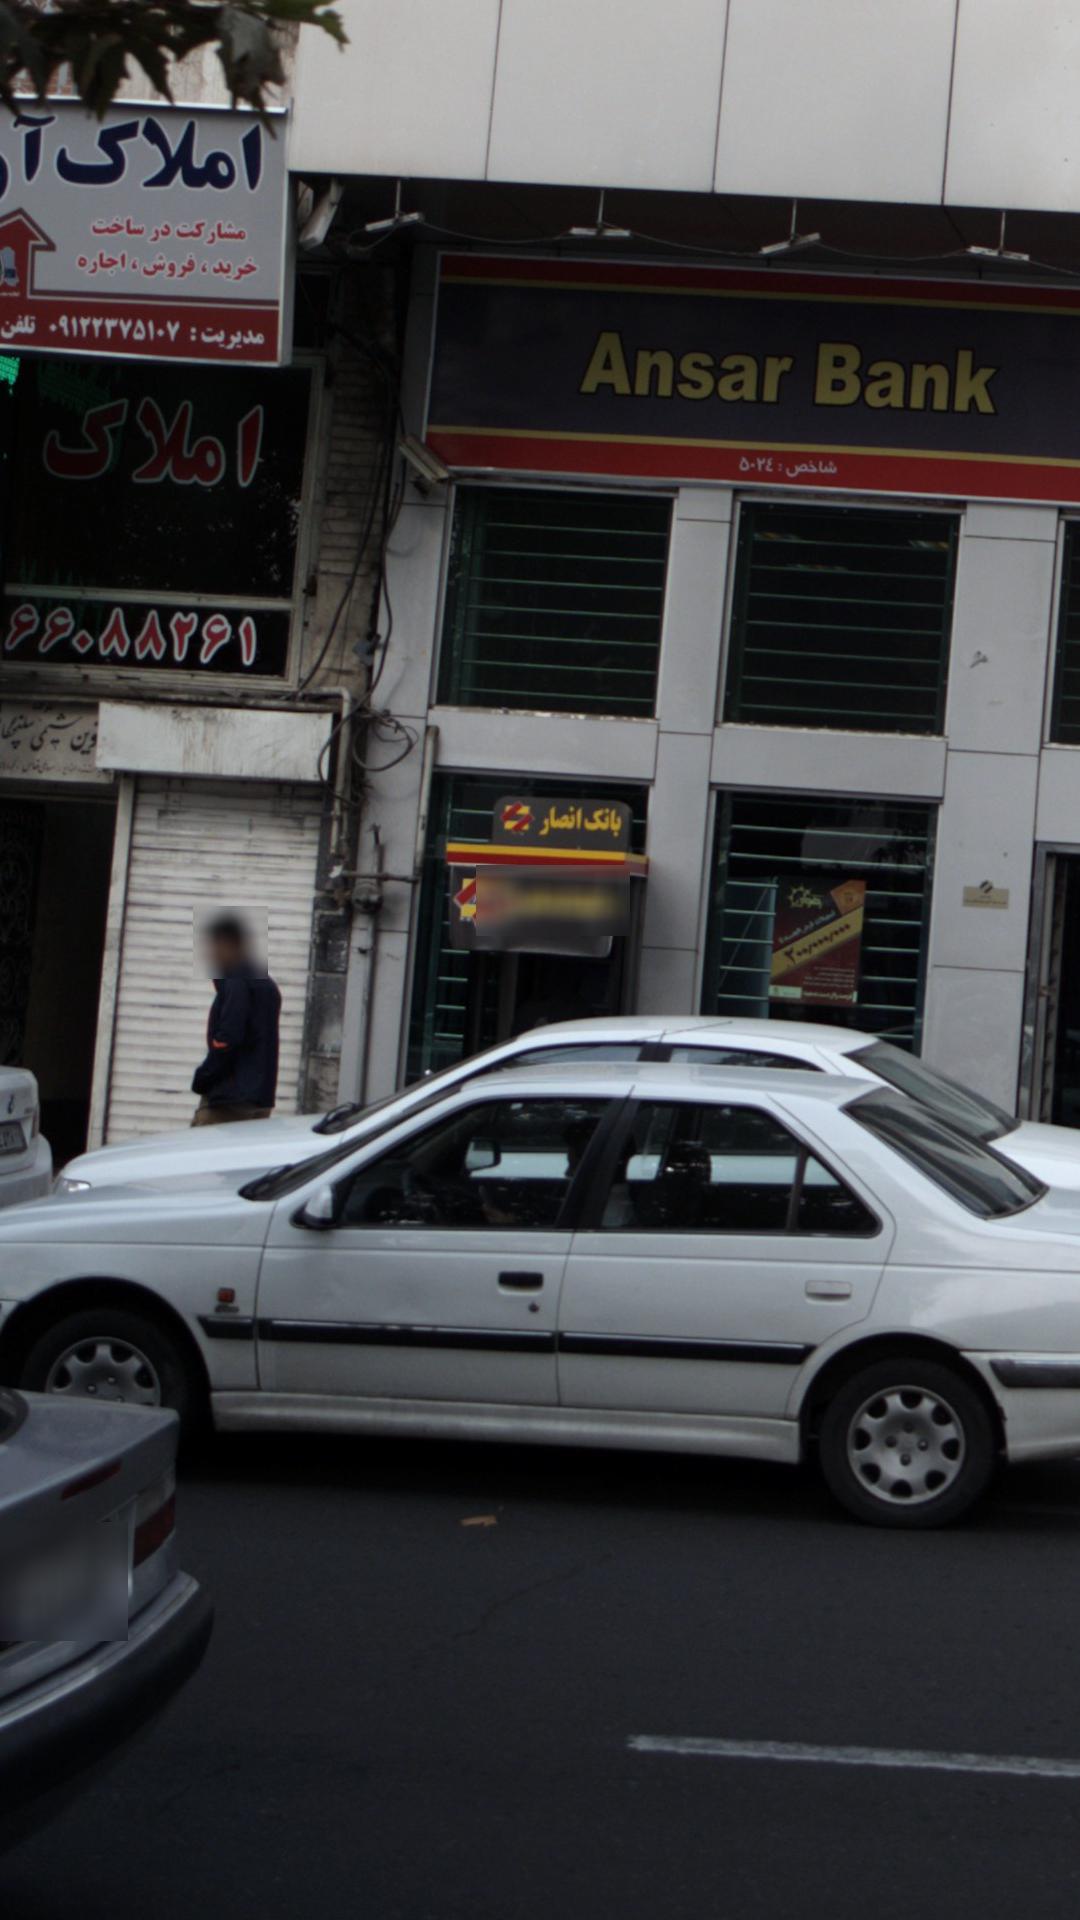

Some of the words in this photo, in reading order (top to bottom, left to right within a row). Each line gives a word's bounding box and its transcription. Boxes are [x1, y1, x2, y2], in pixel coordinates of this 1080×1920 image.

[56, 116, 262, 190] املاک
[91, 217, 145, 236] ساخت
[150, 223, 171, 242] در
[176, 221, 247, 244] مشارکت
[77, 251, 127, 275] اجاره
[0, 314, 36, 338] تلفن
[579, 331, 794, 403] Ansar
[813, 342, 998, 415] Bank
[42, 397, 264, 489] املاک
[4, 603, 258, 666] ۶۶۰۸۸۲۶۱
[539, 805, 582, 835] انصار
[584, 807, 622, 837] بانک
